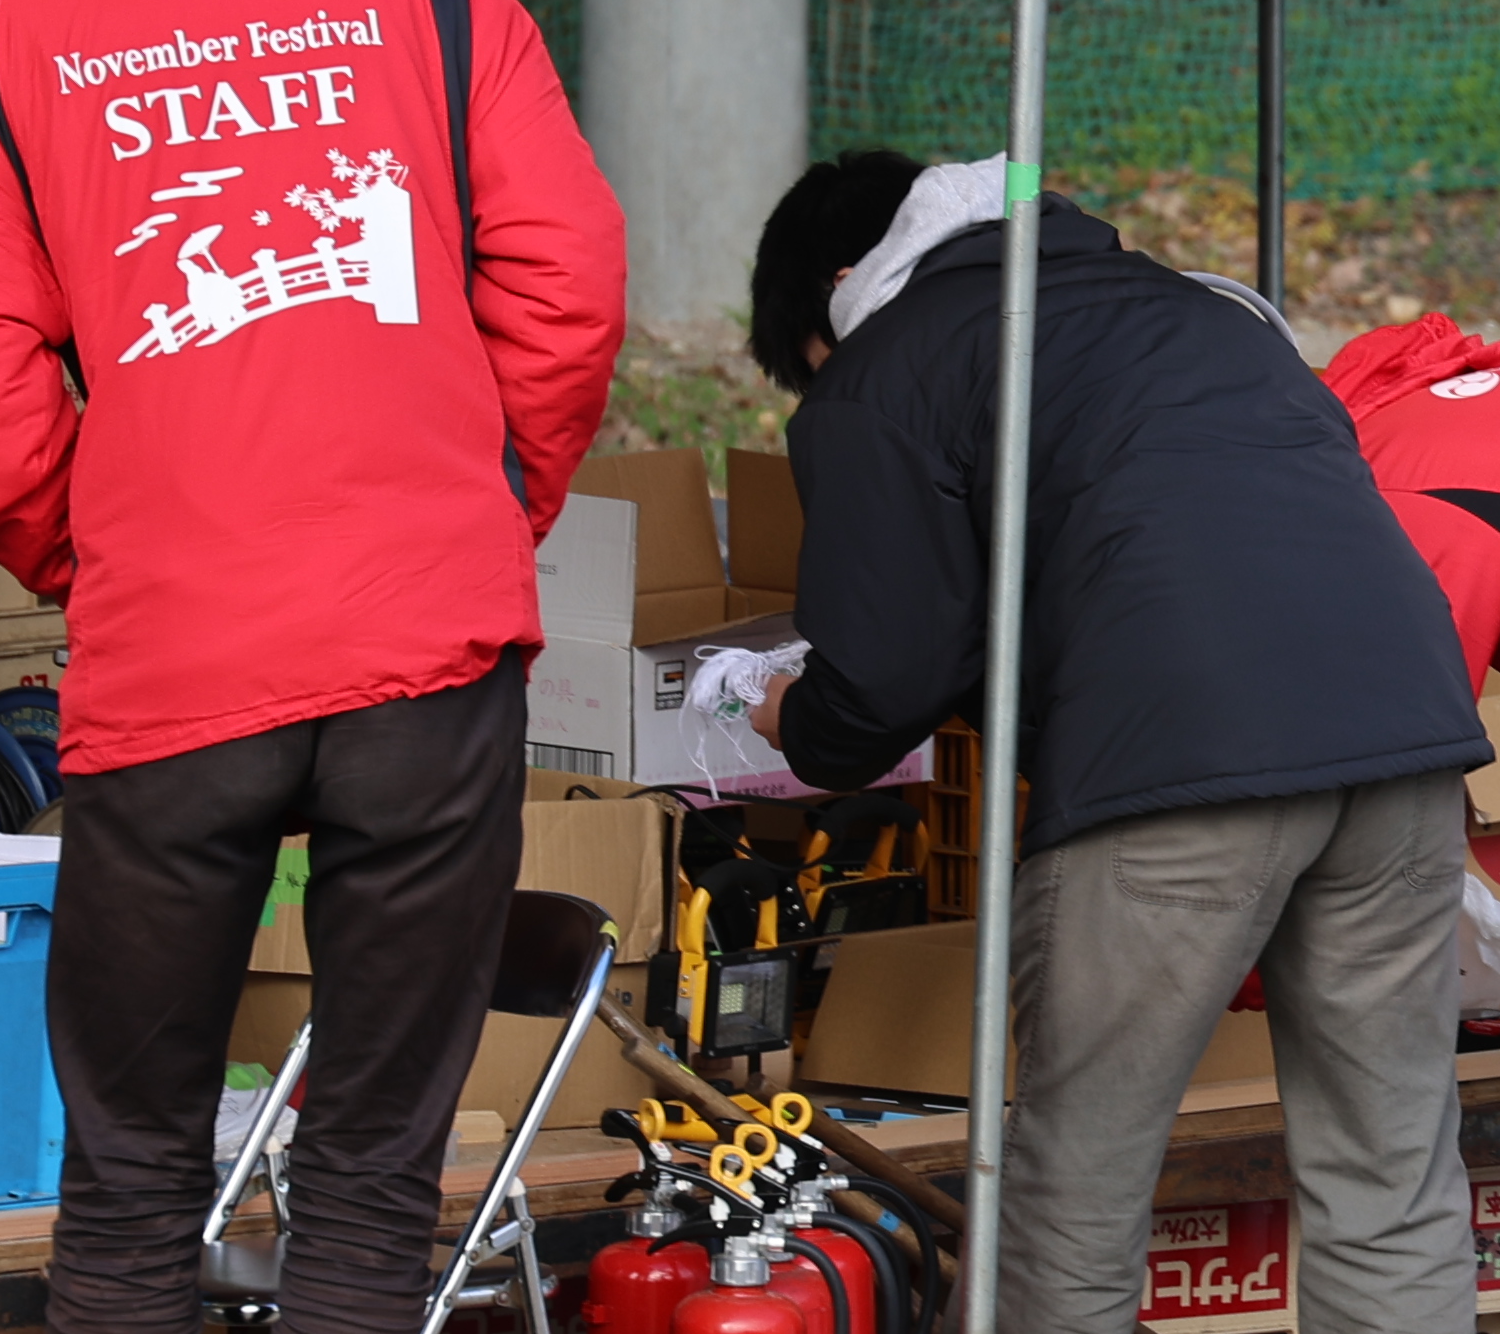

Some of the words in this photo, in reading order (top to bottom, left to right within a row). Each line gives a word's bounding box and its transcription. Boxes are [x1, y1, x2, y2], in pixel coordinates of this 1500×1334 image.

[55, 29, 239, 95] November
[247, 8, 384, 58] Festival
[104, 65, 355, 162] STAFF
[1142, 1252, 1281, 1310] アサヒ
